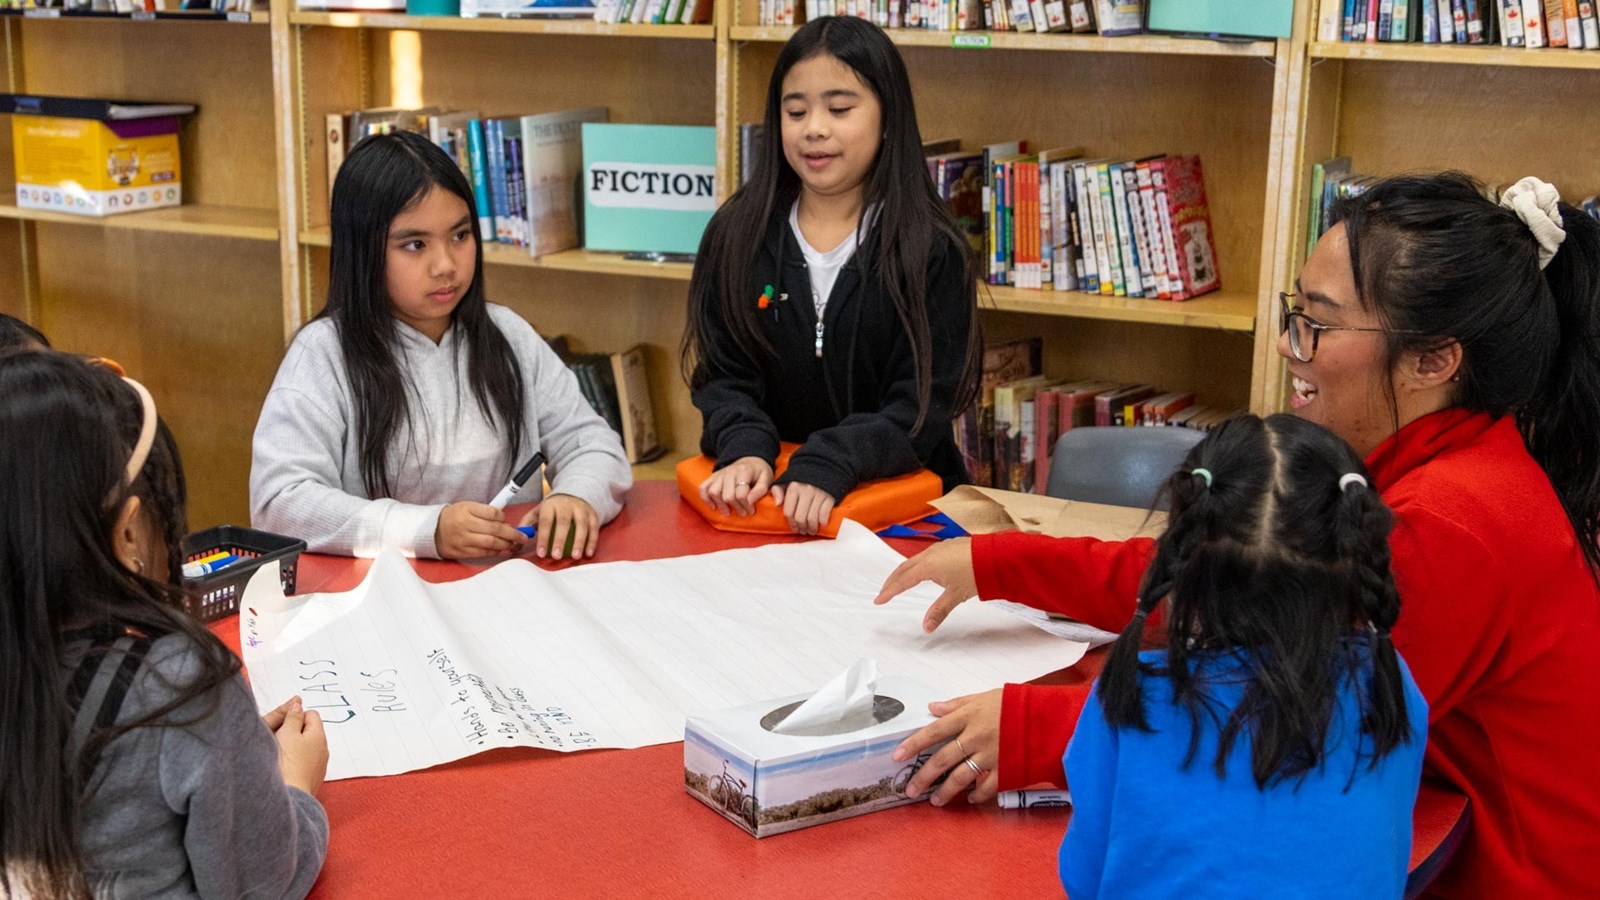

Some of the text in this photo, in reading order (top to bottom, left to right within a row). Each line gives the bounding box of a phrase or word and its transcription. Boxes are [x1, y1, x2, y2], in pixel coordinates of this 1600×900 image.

[591, 169, 715, 197] FICTION
[299, 660, 356, 723] CLASS
[427, 648, 488, 742] Hands to yourself
